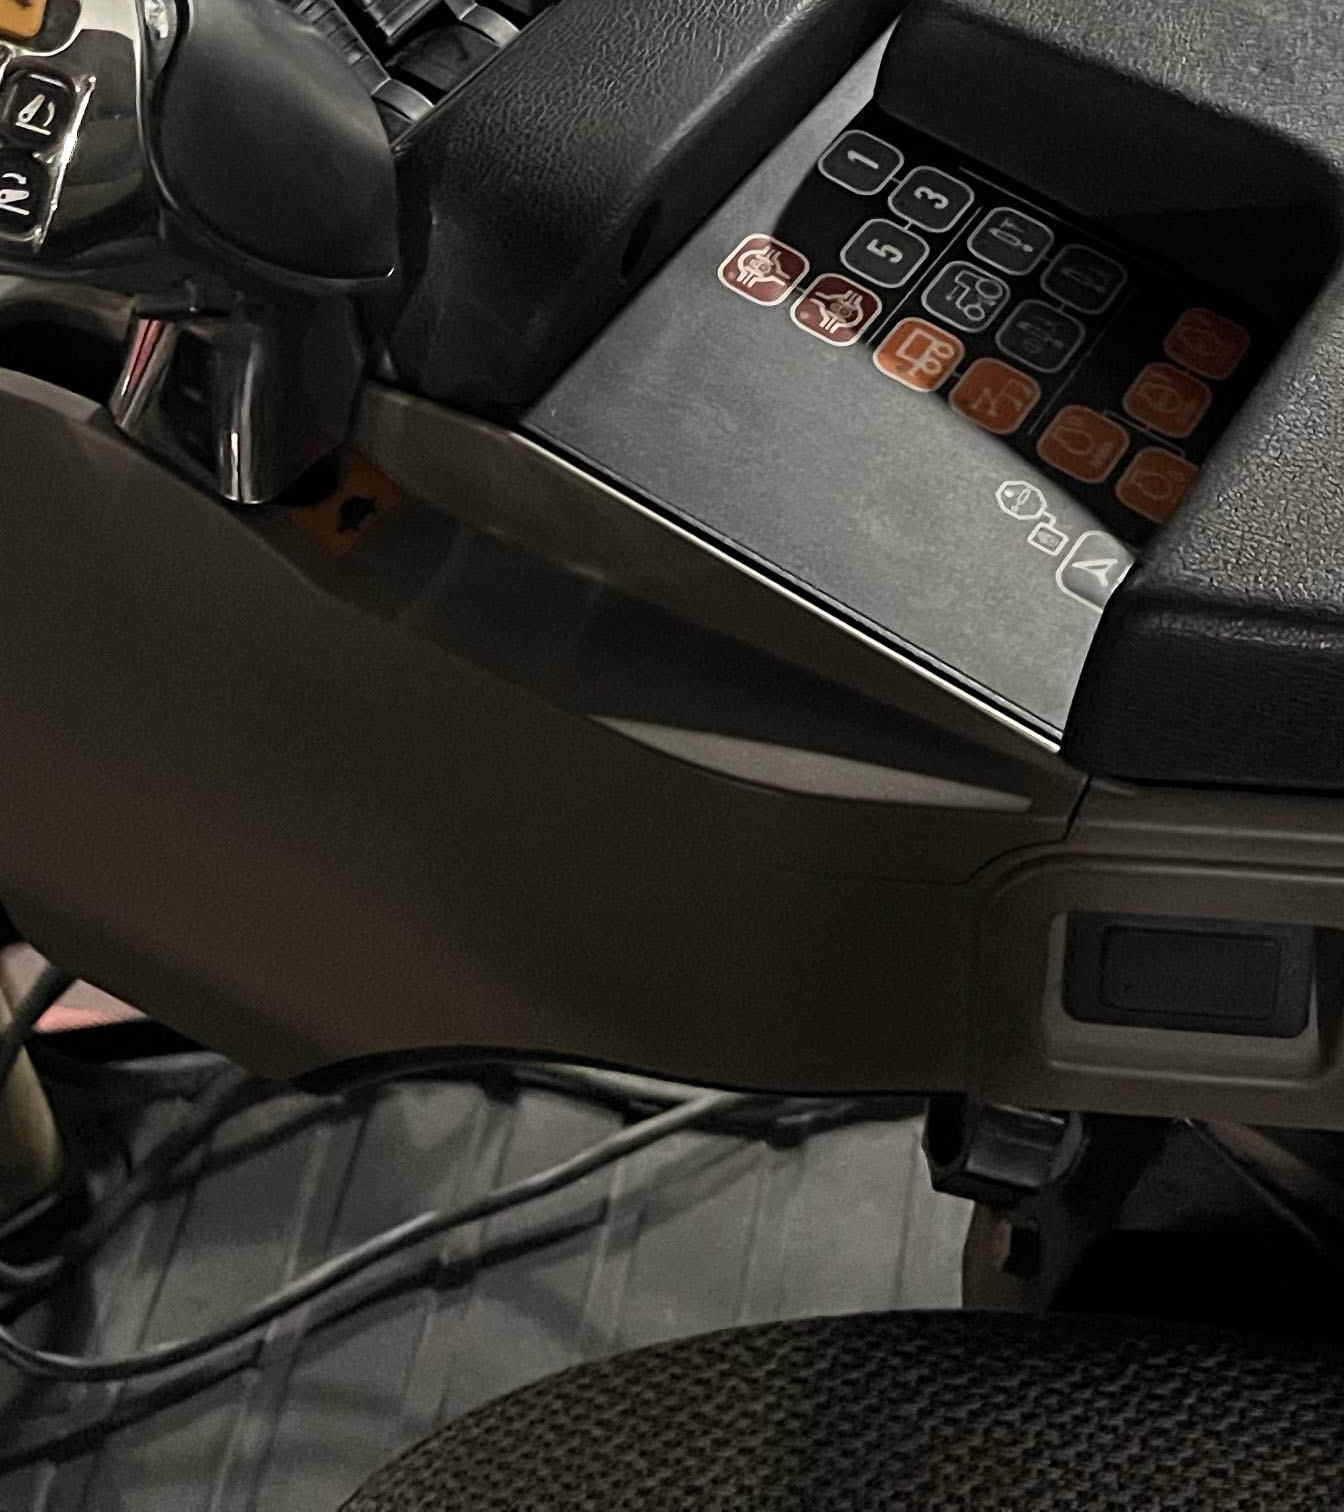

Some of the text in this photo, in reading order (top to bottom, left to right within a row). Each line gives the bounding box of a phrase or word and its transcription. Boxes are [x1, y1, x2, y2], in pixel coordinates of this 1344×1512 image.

[847, 149, 880, 170] 1
[913, 184, 950, 210] 3
[866, 237, 905, 264] 5
